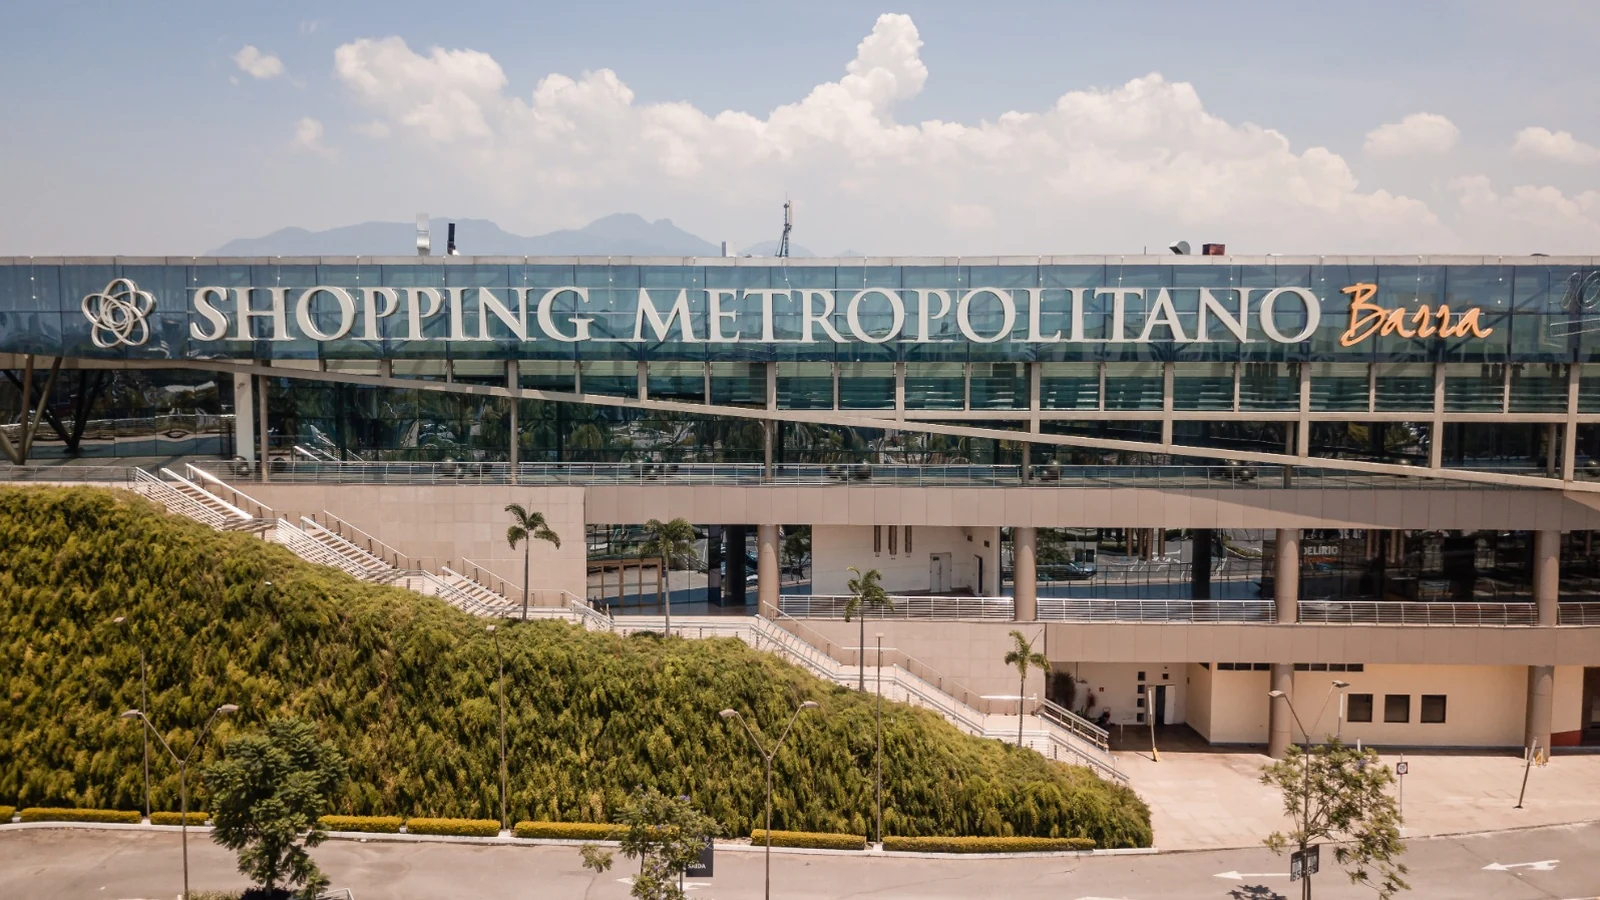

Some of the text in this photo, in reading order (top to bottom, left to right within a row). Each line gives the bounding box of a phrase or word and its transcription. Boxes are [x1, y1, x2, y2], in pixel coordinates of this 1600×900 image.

[189, 282, 1493, 347] SHOPPING METROPOLITANO Barra
